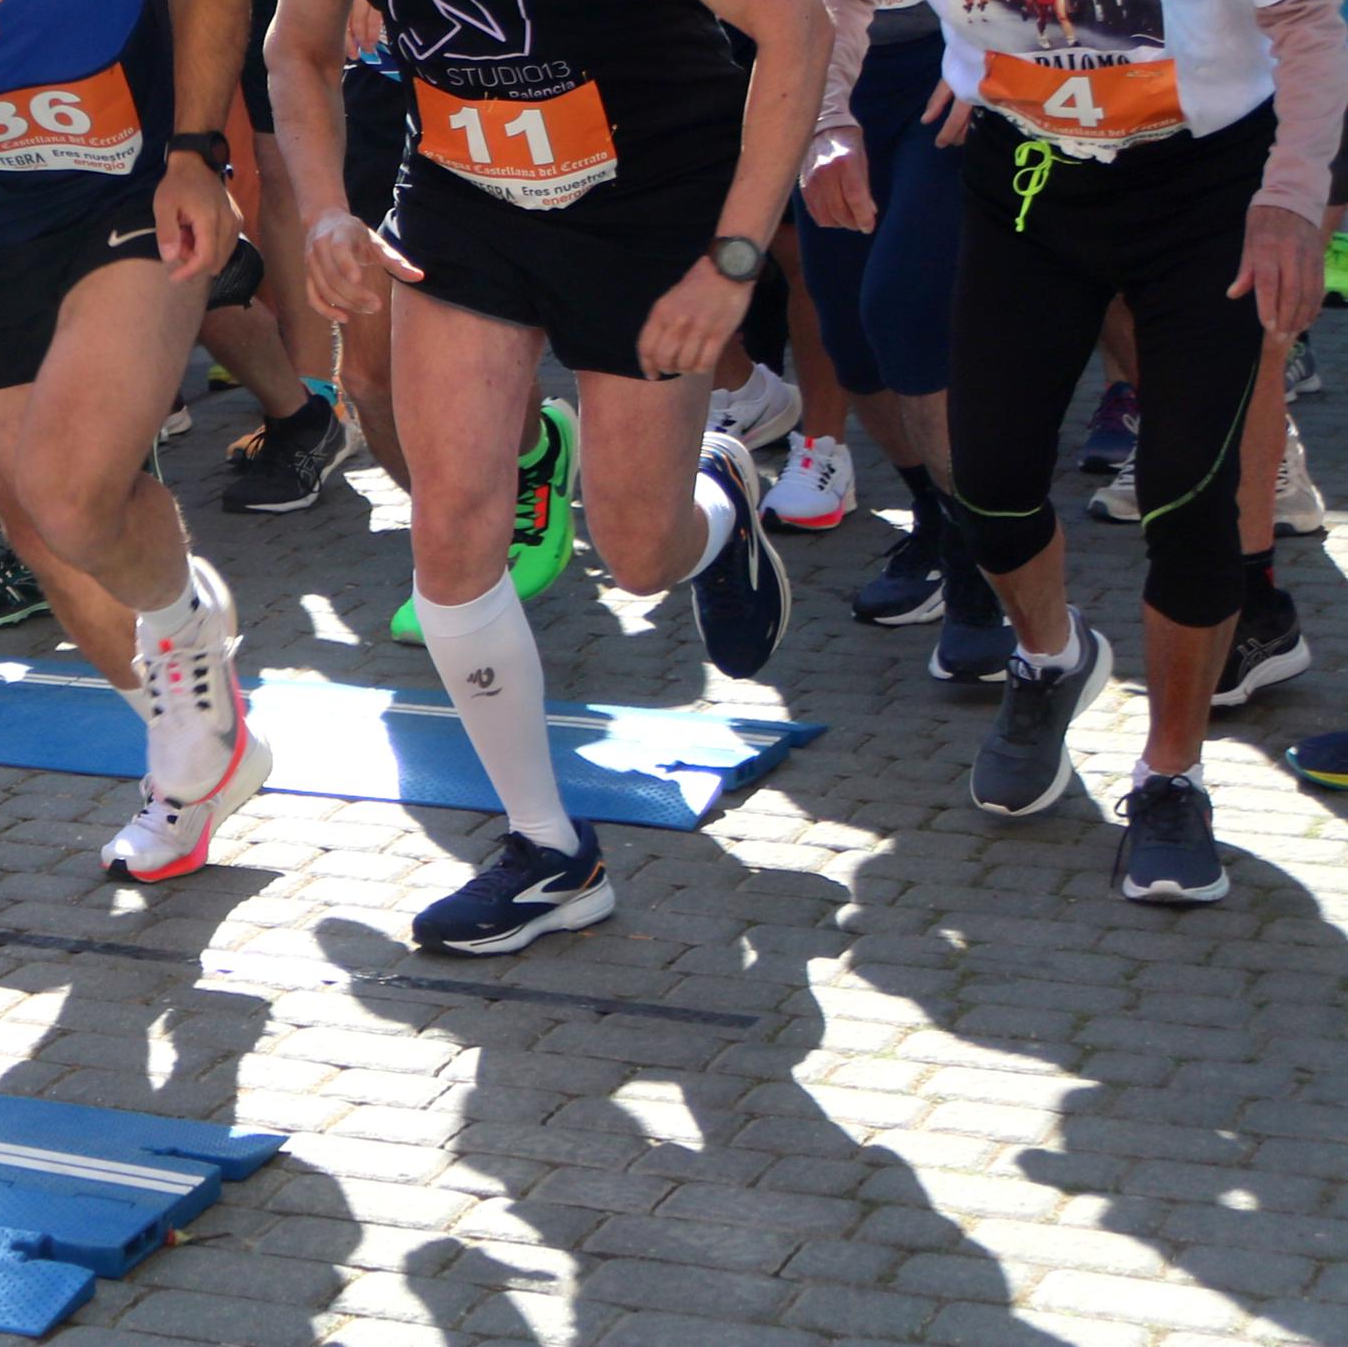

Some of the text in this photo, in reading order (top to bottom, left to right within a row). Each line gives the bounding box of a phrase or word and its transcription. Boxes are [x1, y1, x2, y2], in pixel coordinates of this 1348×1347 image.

[446, 60, 572, 88] STUDIO13
[508, 79, 576, 99] Palencia
[1043, 76, 1104, 128] 4
[0, 134, 65, 149] Castellana
[67, 134, 86, 145] del
[88, 127, 135, 147] Cerrato
[449, 106, 555, 166] 11
[51, 149, 81, 158] Eres
[83, 146, 135, 162] nuestra
[473, 165, 536, 178] Castellana
[538, 166, 557, 179] del
[560, 151, 608, 173] Cerrato
[521, 186, 550, 197] Eres
[553, 169, 607, 195] nuestra
